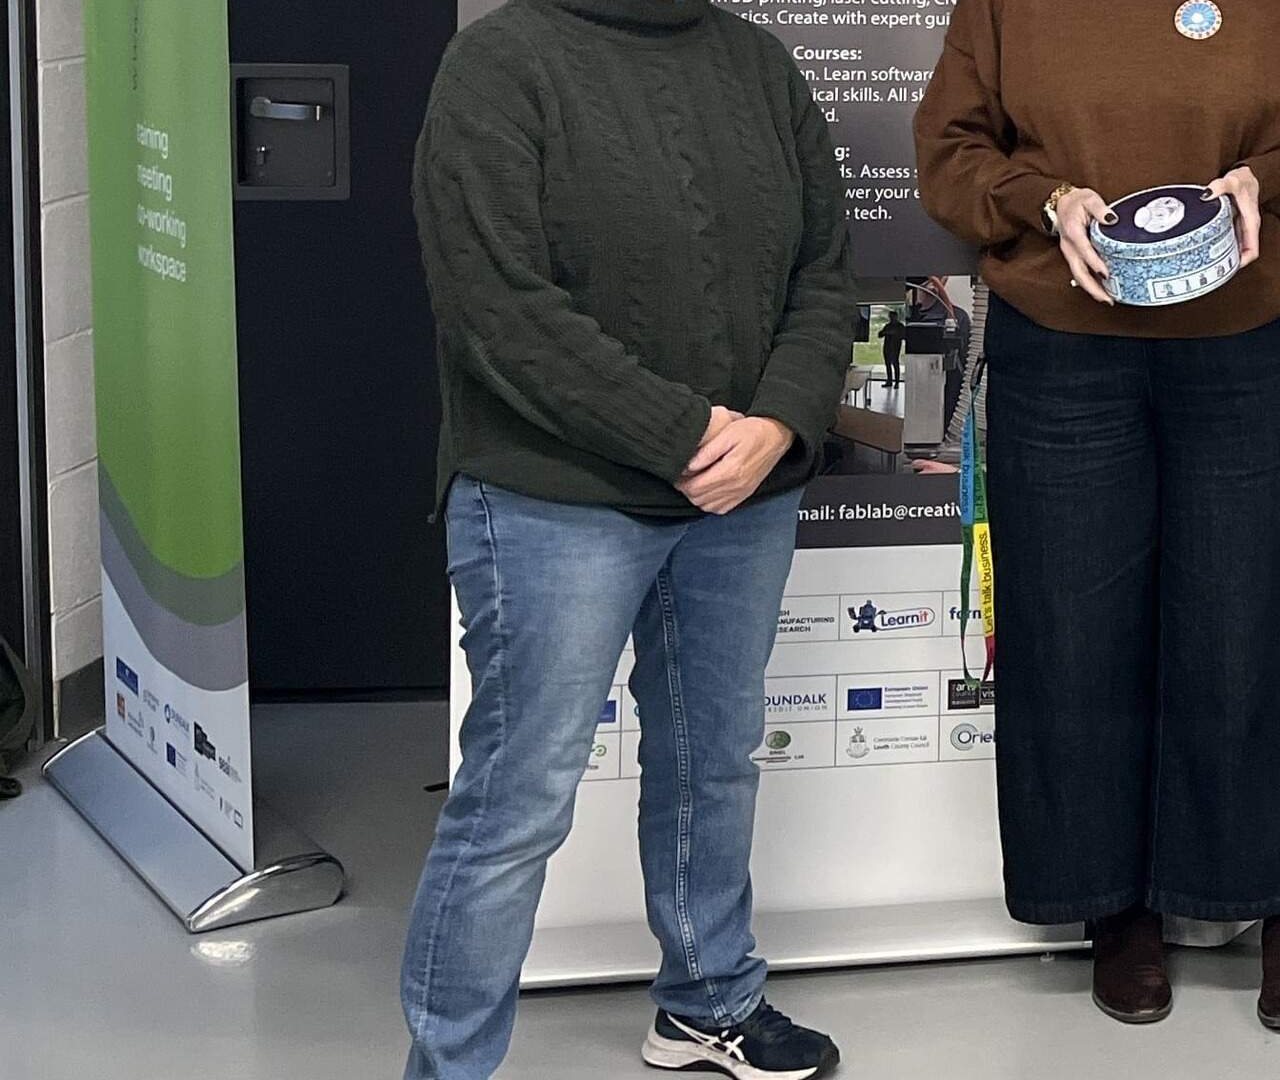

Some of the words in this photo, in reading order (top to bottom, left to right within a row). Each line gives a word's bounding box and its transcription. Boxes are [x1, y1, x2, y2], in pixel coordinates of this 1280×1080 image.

[737, 10, 773, 24] sics.
[777, 10, 828, 24] Create
[832, 11, 866, 25] with
[871, 13, 921, 29] expert
[793, 46, 862, 60] Courses:
[824, 67, 866, 81] Learn
[842, 88, 883, 102] skills.
[887, 88, 907, 102] All
[860, 164, 910, 178] Assess
[875, 188, 911, 202] your
[854, 205, 893, 220] tech.
[798, 504, 835, 520] mail:
